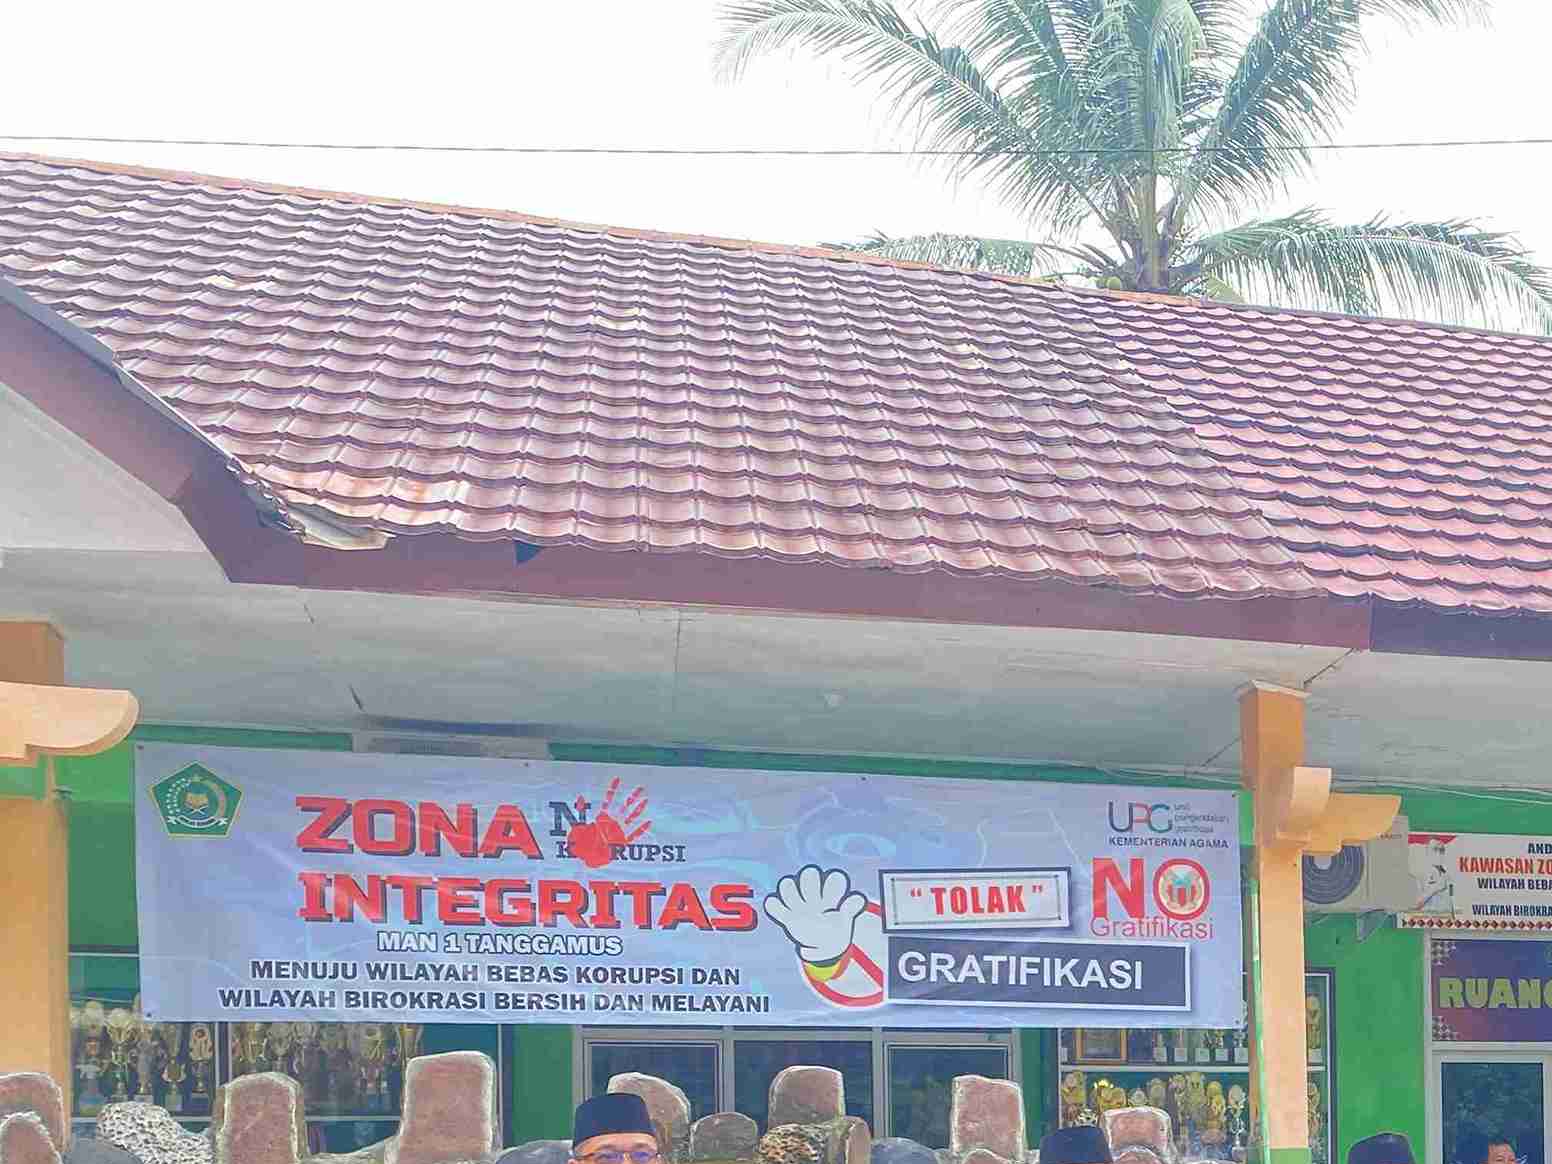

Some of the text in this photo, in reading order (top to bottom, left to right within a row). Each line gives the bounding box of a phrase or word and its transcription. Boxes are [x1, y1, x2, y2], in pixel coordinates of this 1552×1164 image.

[295, 795, 544, 861] ZONA
[1107, 801, 1173, 833] UPG
[1108, 836, 1230, 849] KEMENTERIAN AGAMA
[1459, 856, 1534, 874] KAWASAN
[1091, 857, 1211, 922] NO
[1477, 877, 1525, 890] WILAYAH
[296, 871, 758, 932] INTEGRITAS
[1471, 904, 1512, 916] WILAYAH
[1089, 914, 1214, 940] Gratifikasi
[377, 930, 624, 956] MAN 1 TANGGAMUS
[250, 960, 741, 985] MENUJU WILAYAH BEBAS KORUPSI DAN
[897, 950, 1143, 991] GRATIFIKASI
[217, 988, 769, 1013] WILAYAH BIROKRASI BERSIH DAN MELAYANI
